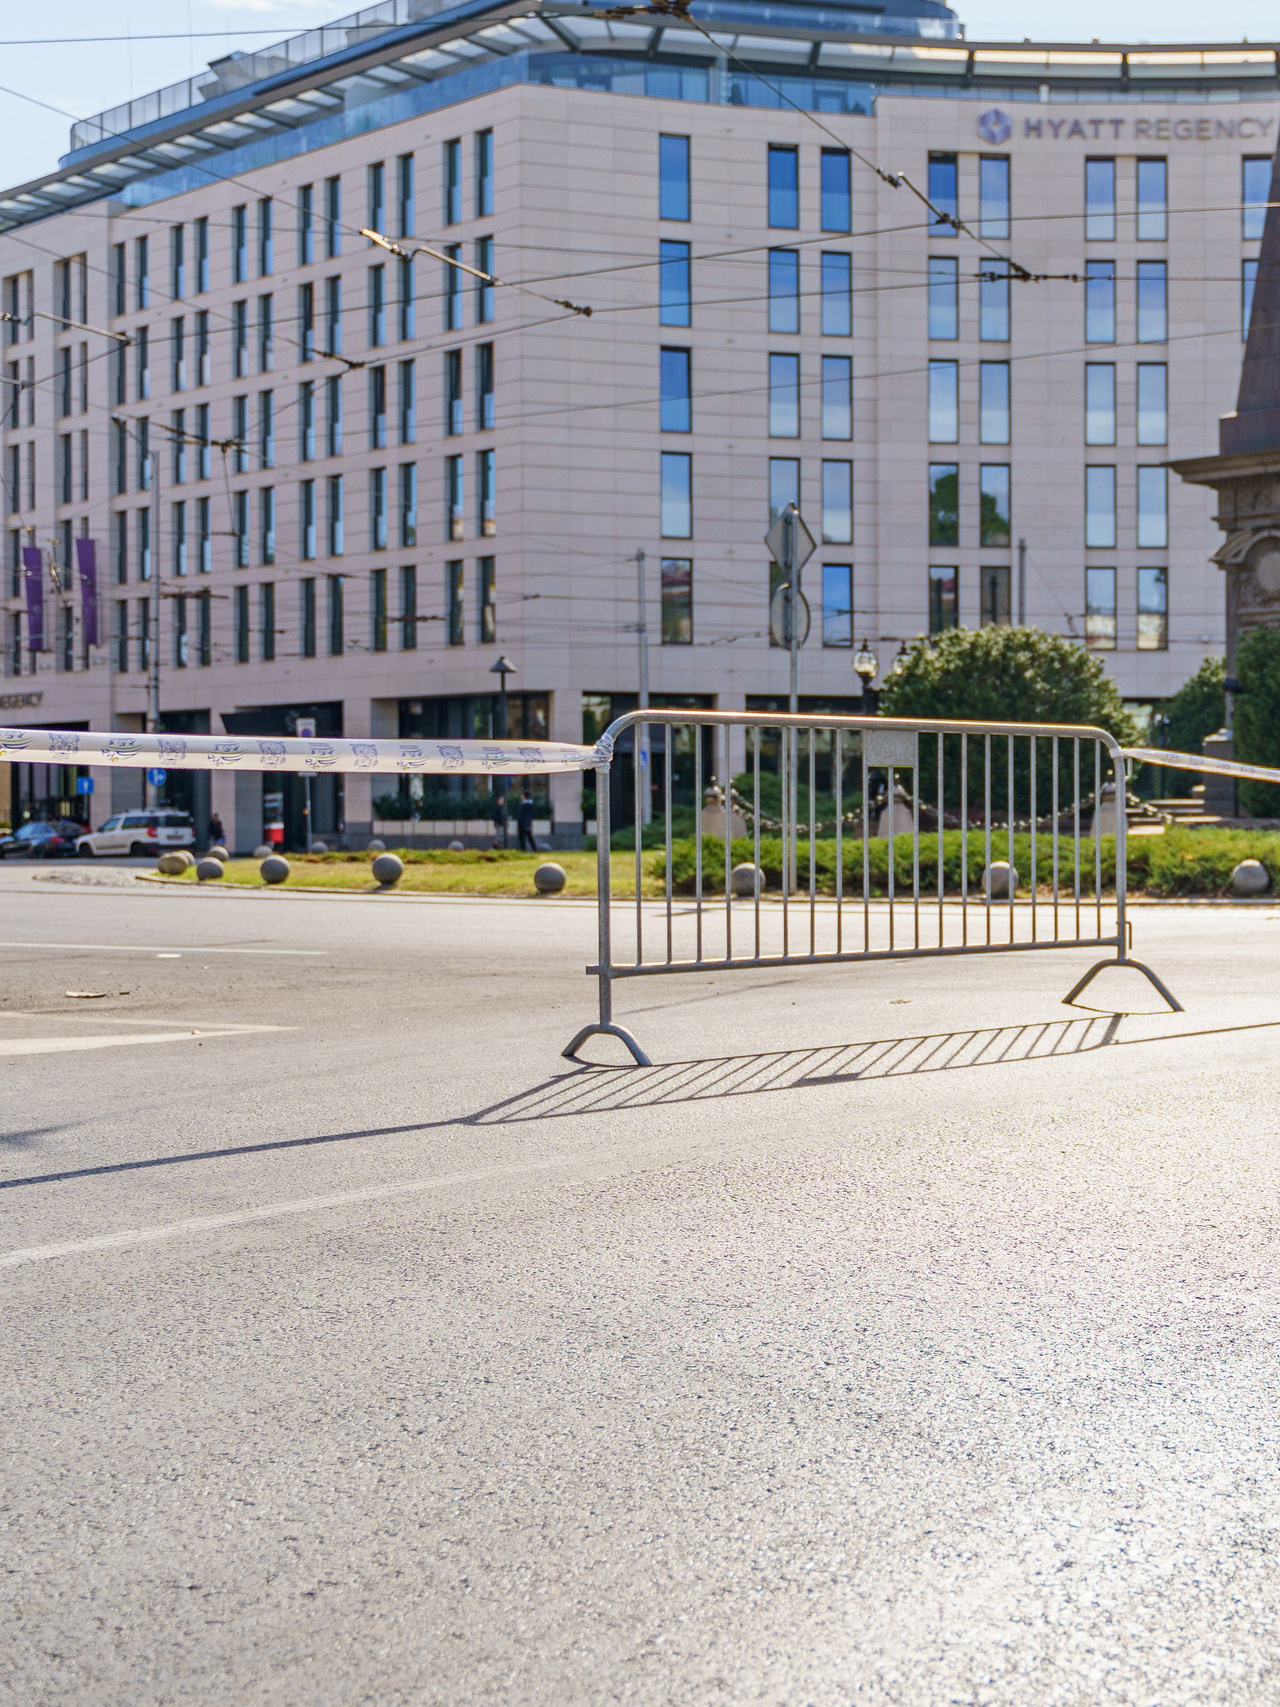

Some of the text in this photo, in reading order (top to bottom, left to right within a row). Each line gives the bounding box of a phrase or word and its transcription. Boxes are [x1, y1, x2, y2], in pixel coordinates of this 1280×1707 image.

[1024, 117, 1274, 141] HYATT REGENCY
[0, 691, 44, 710] EGENCY
